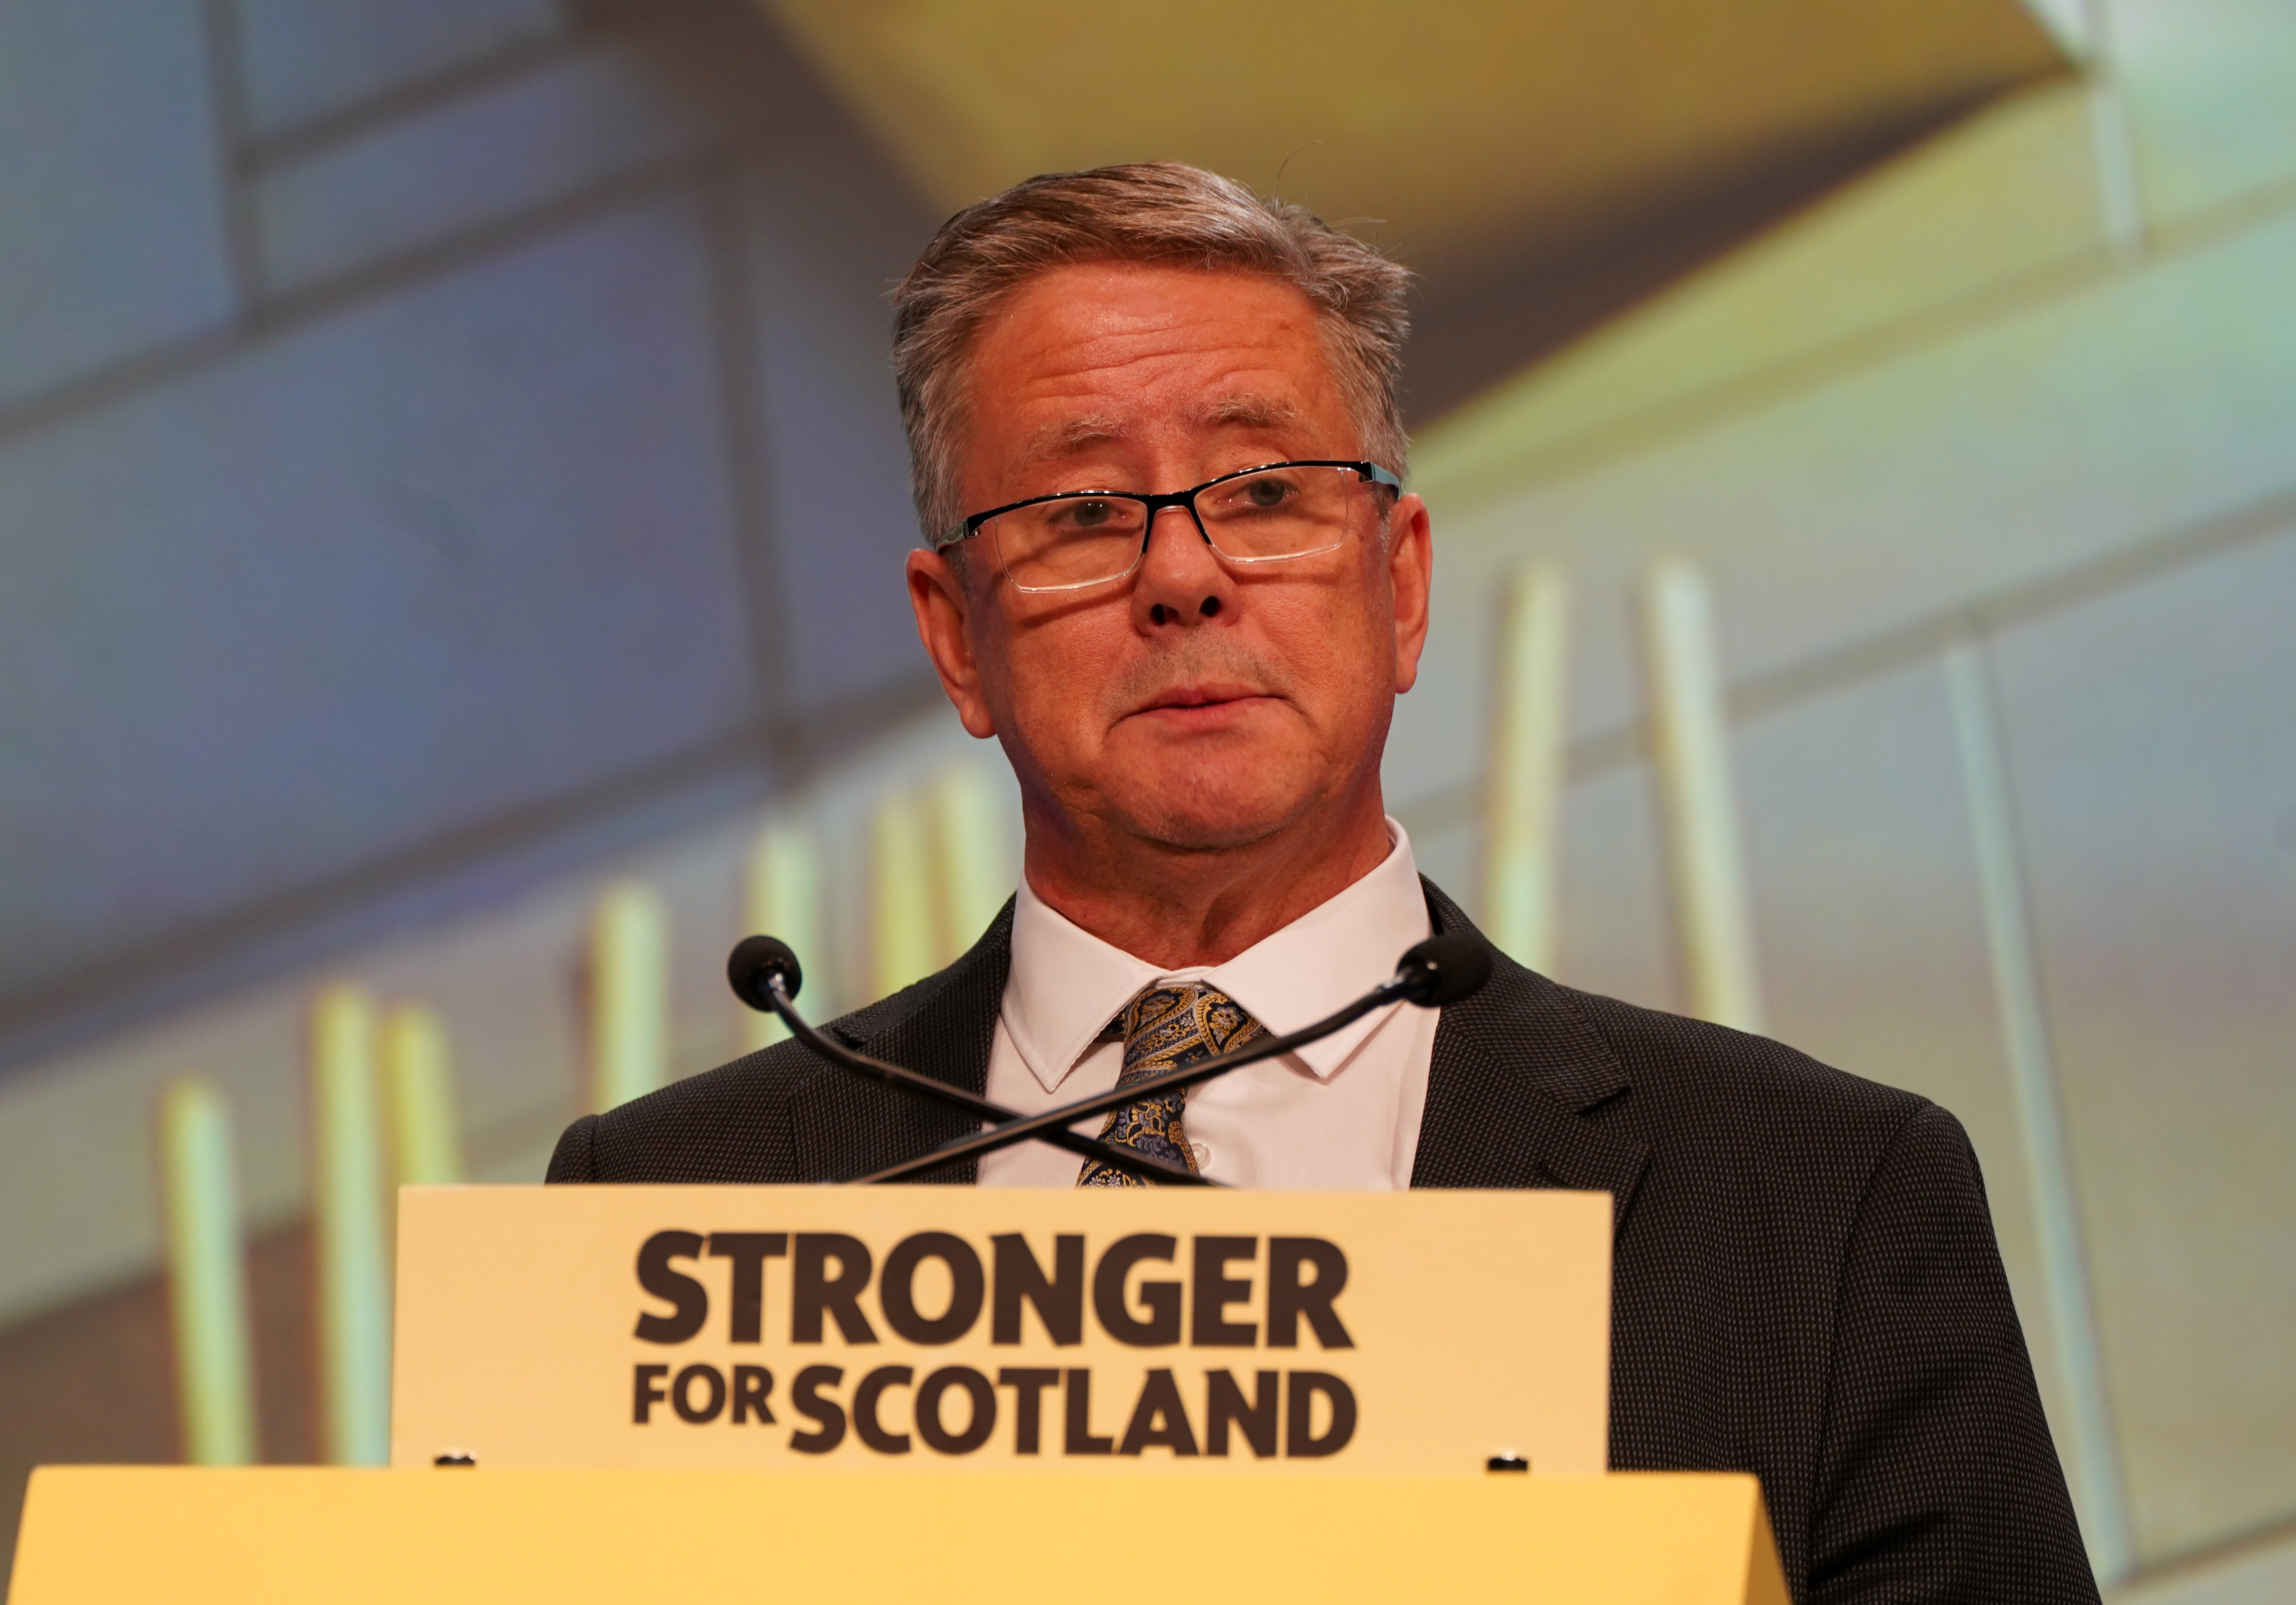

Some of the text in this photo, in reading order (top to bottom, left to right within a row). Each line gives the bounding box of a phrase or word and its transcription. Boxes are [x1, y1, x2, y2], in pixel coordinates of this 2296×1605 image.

[633, 1230, 1356, 1350] STRONGER
[633, 1363, 1358, 1459] FOR SCOTLAND
